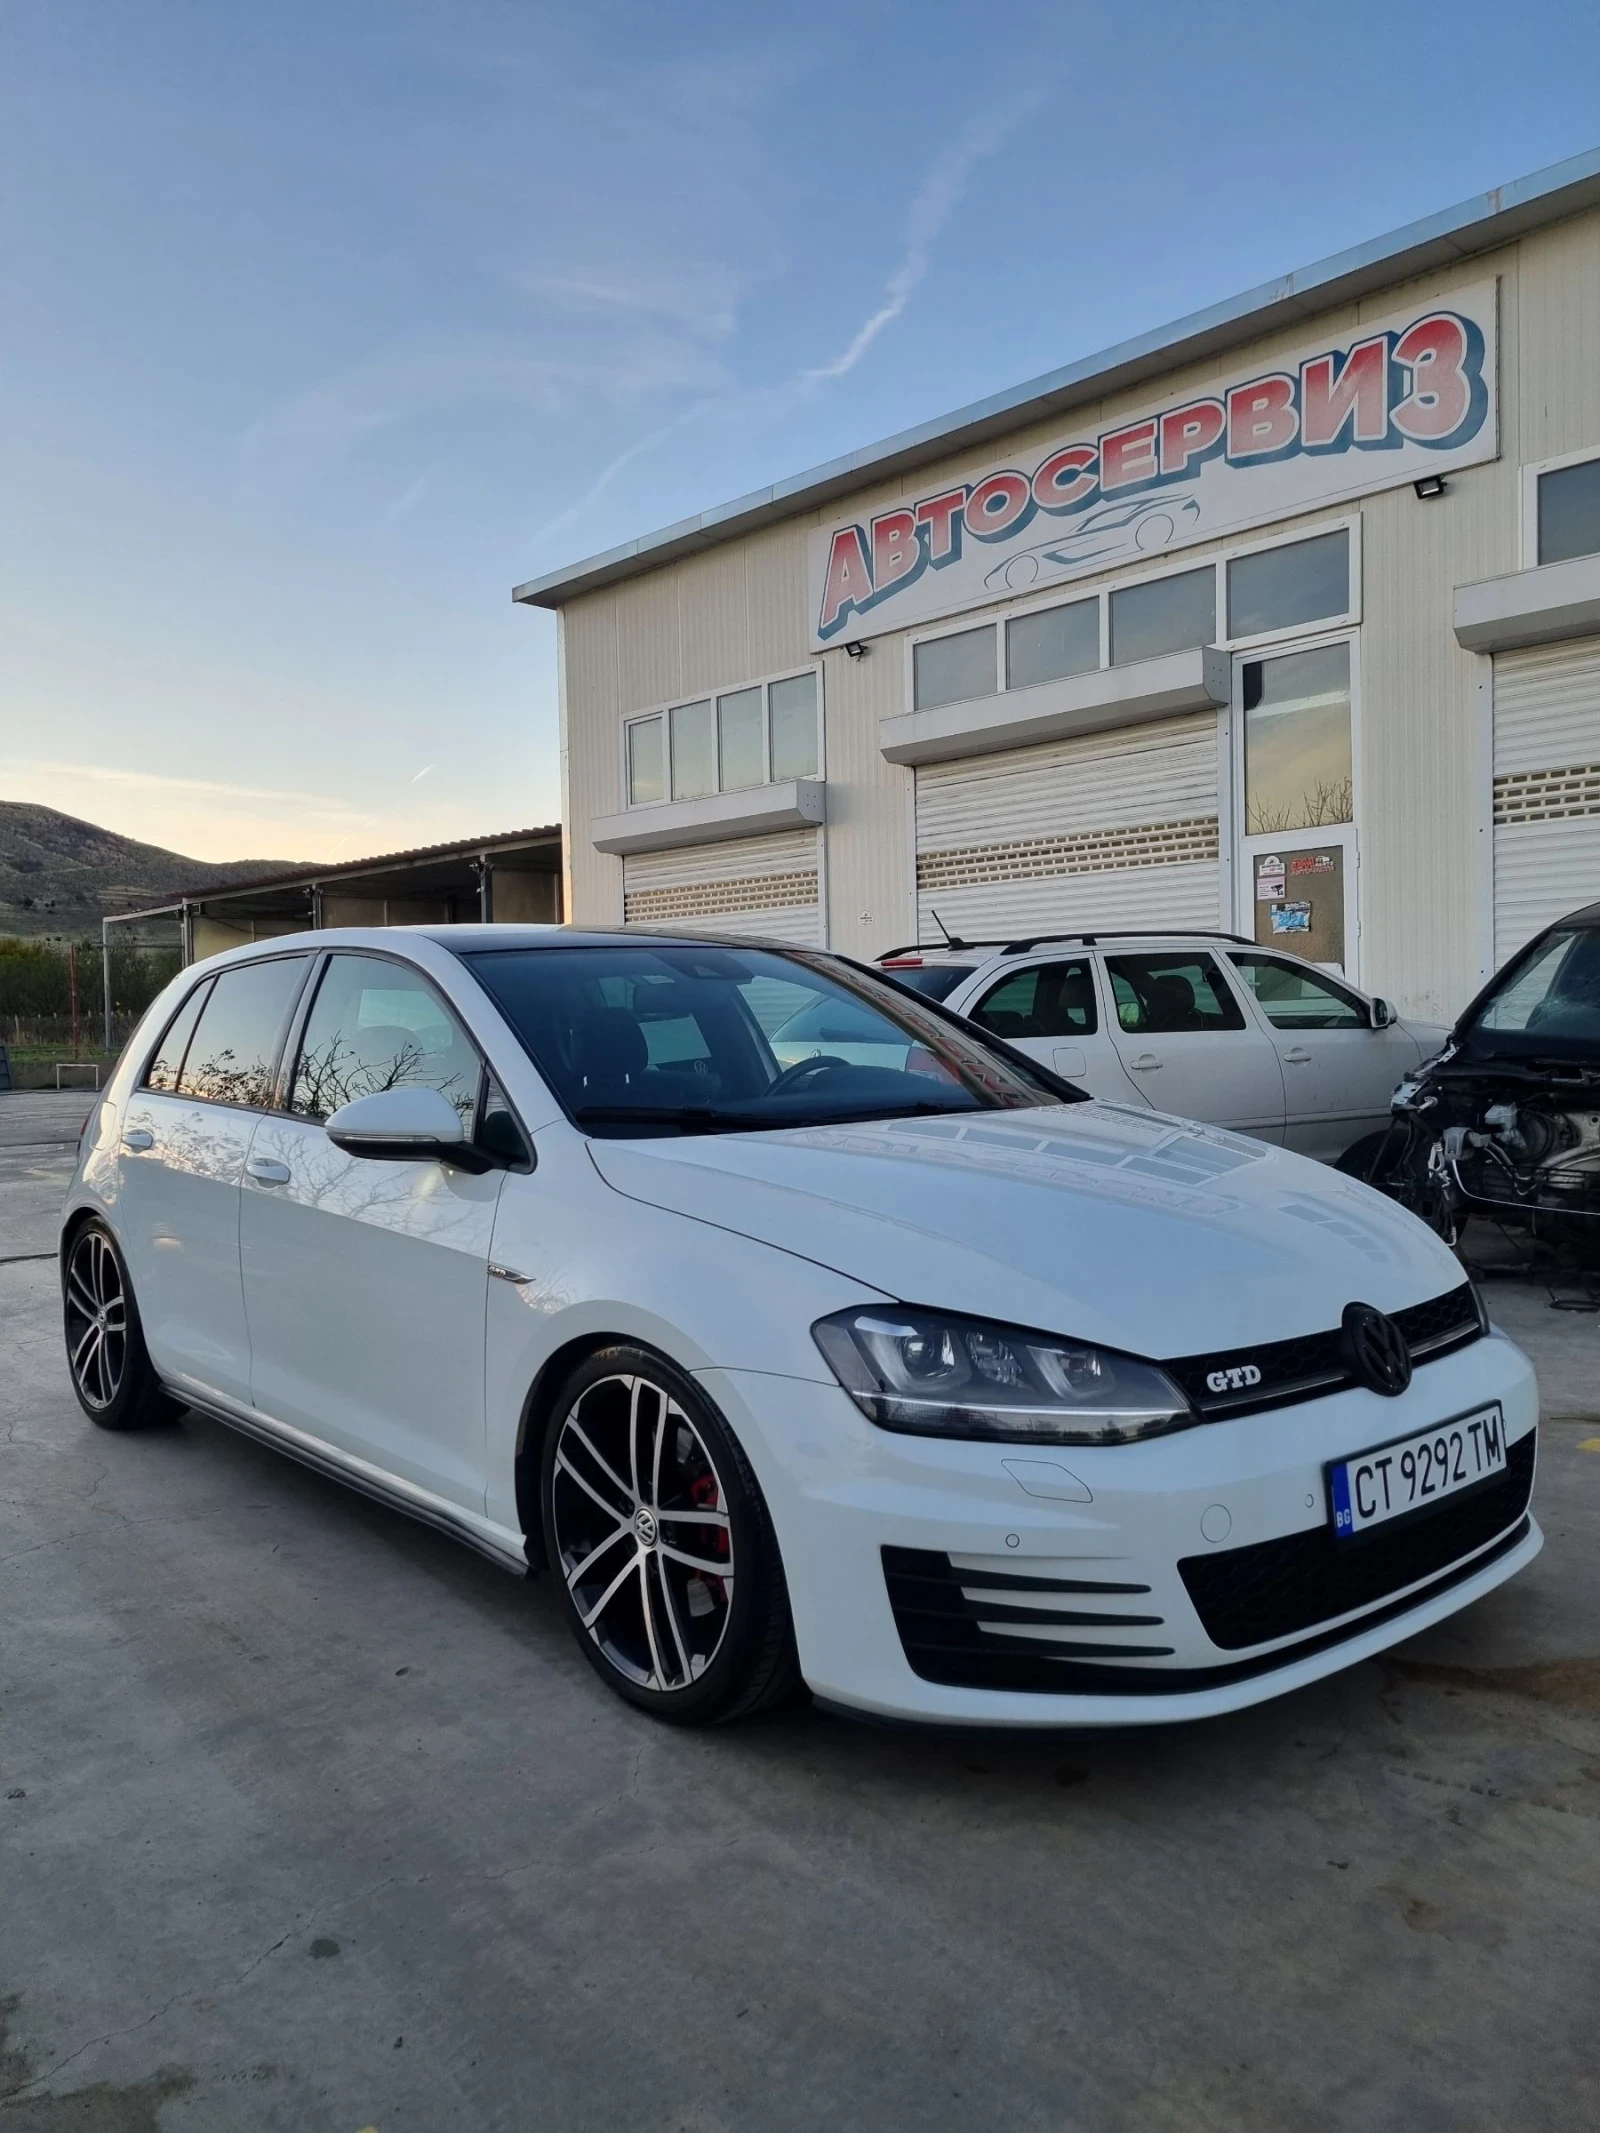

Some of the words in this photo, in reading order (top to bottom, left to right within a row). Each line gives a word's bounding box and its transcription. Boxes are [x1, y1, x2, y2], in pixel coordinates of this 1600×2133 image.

[818, 311, 1487, 641] АВТОСЕРВИЗ
[1206, 1364, 1262, 1392] GTD
[1355, 1456, 1393, 1519] CT
[1400, 1431, 1467, 1502] 9292
[1467, 1415, 1502, 1473] TM
[1336, 1508, 1351, 1528] BG
